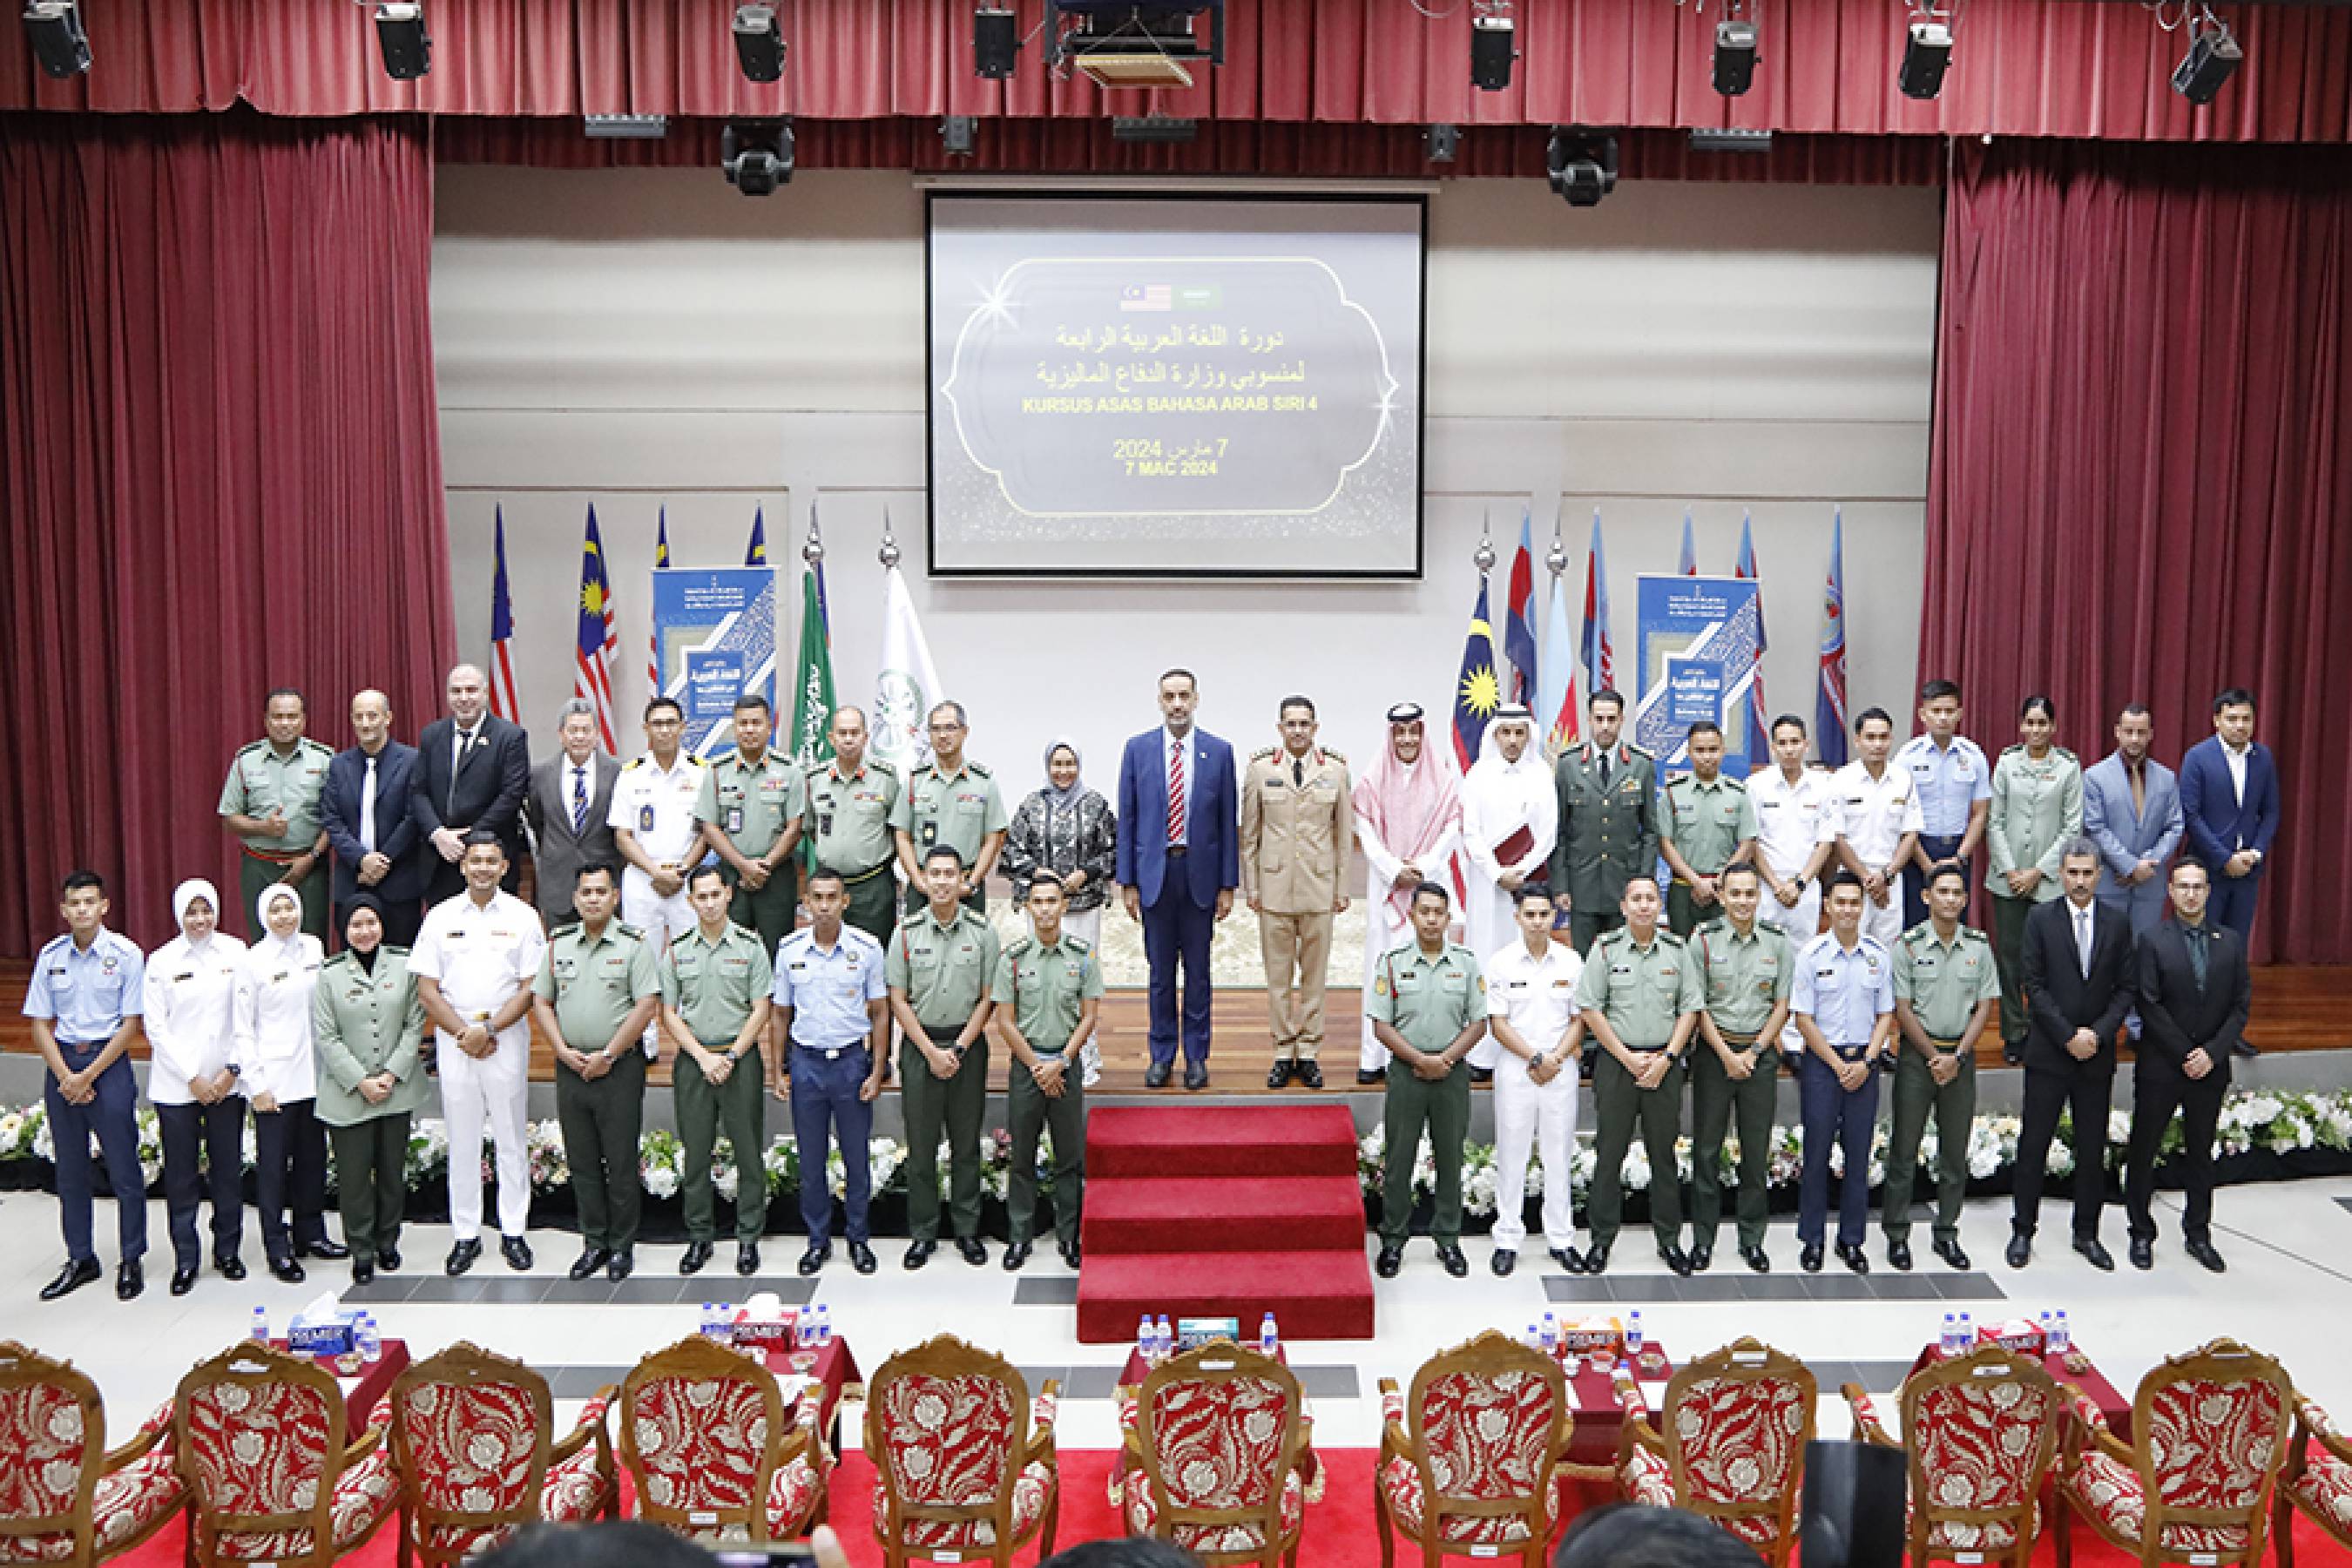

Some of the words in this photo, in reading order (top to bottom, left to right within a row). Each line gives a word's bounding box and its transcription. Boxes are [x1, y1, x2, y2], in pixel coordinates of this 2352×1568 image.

[1056, 324, 1117, 354] الرابعة
[1121, 324, 1182, 354] العربية
[1187, 324, 1227, 346] اللغة
[1240, 326, 1284, 353] دورة
[1037, 361, 1111, 390] الماليزية
[1115, 361, 1166, 392] الدفاع
[1171, 362, 1227, 390] وزارة
[1231, 361, 1305, 390] لمنسوبي
[1021, 396, 1093, 412] KURSUS
[1097, 396, 1143, 411] ASAS
[1146, 396, 1219, 411] BAHASA
[1220, 395, 1269, 411] ARAB
[1273, 395, 1305, 411] SIRI
[1308, 395, 1318, 411] 4
[1113, 438, 1163, 459] 2024
[1167, 439, 1212, 462] مارس
[1216, 438, 1229, 458] 7
[1124, 460, 1134, 476] 7
[1139, 460, 1177, 476] MAC
[1180, 460, 1219, 476] 2024
